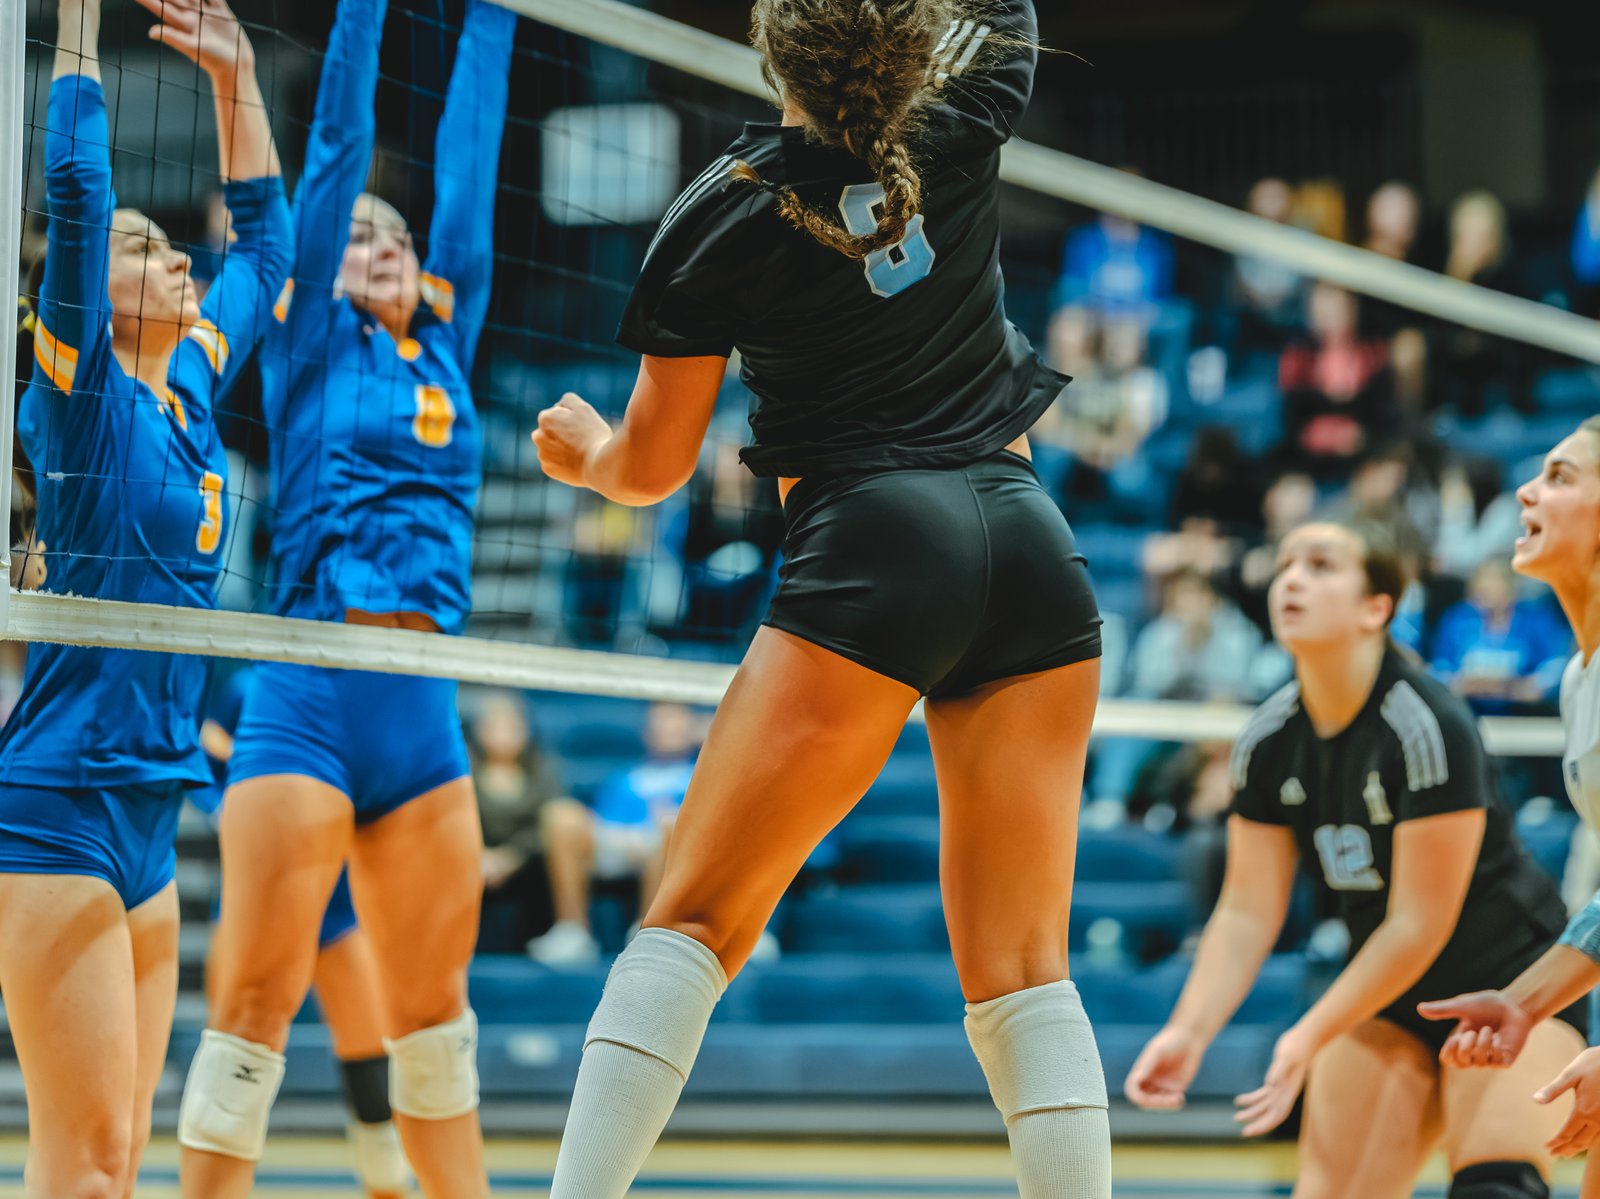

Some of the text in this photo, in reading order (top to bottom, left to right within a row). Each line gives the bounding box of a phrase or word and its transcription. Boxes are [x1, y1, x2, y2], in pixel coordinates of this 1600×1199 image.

[838, 182, 936, 298] 8
[196, 469, 224, 555] 3
[1313, 823, 1385, 891] 12
